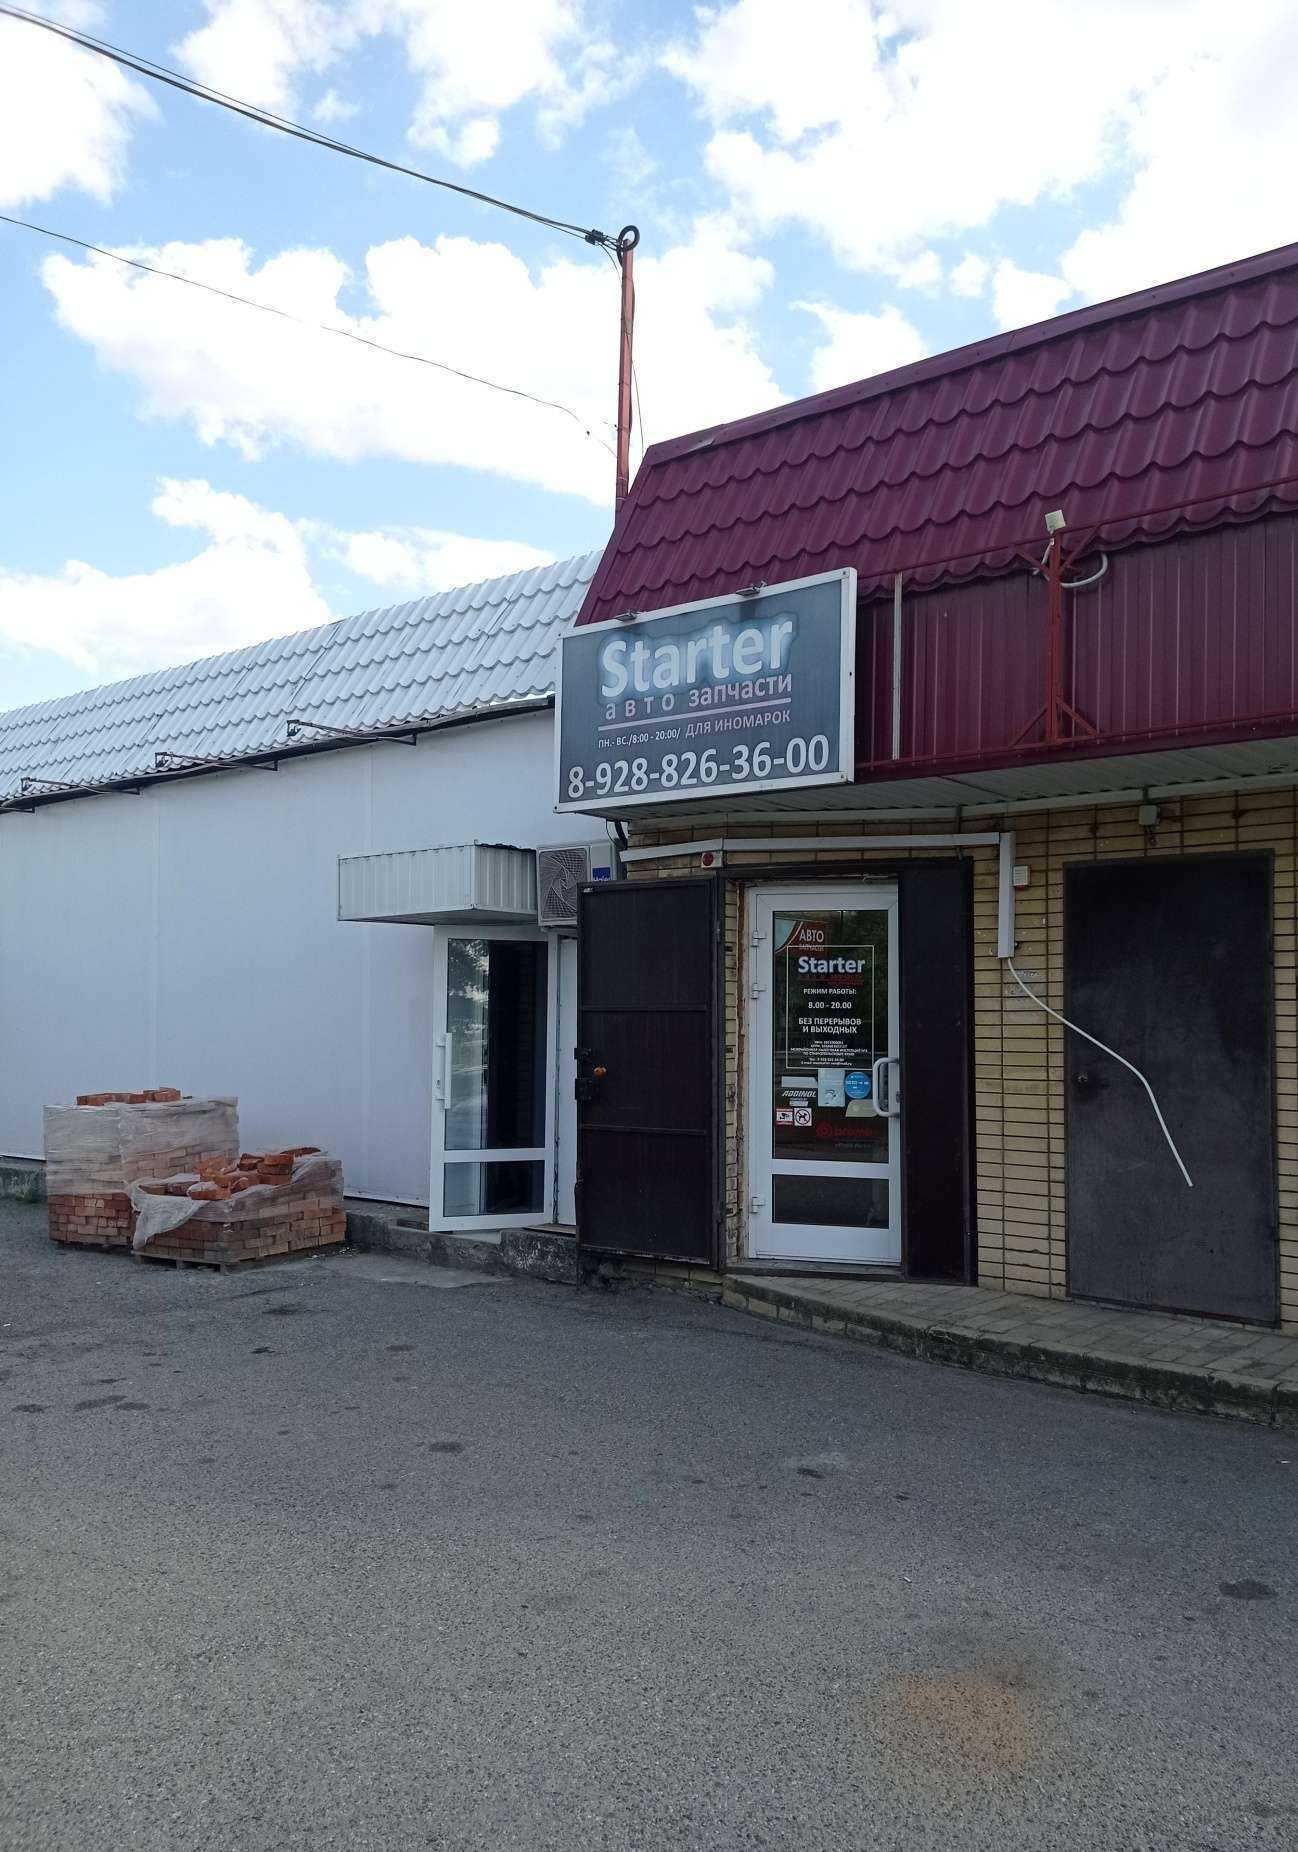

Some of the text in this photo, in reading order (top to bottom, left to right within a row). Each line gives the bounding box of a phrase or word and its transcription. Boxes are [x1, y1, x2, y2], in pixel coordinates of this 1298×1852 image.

[601, 620, 792, 698] Starter
[688, 672, 792, 708] запчасти
[685, 709, 791, 739] ДЛЯ ИНОМАРОК
[568, 734, 829, 798] 8-928-826-36-00
[799, 929, 824, 942] АВТО
[798, 956, 865, 974] Starter
[808, 1001, 825, 1009] 8.00
[830, 1001, 852, 1009] 20.00
[798, 1017, 862, 1026] БЕЗ ПЕРЕРЫВОВ
[802, 1025, 858, 1035] И ВЫХОДНЫХ
